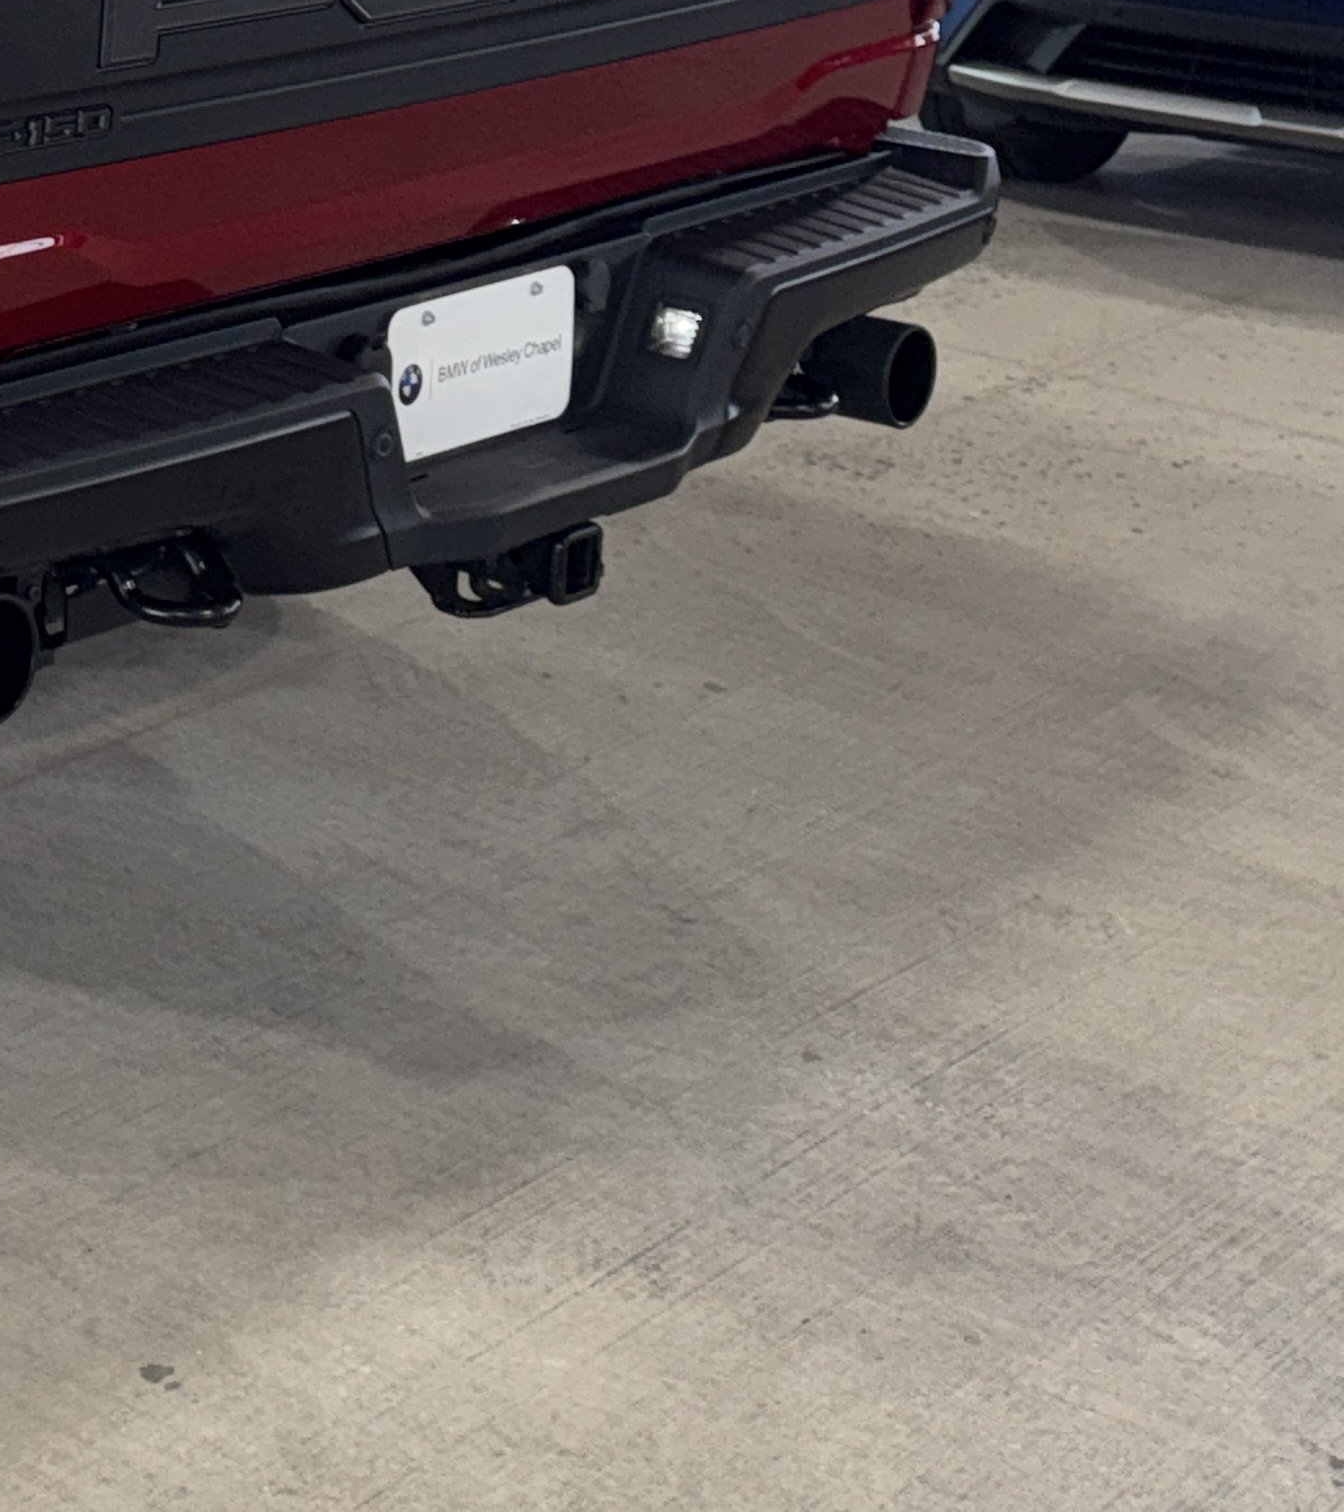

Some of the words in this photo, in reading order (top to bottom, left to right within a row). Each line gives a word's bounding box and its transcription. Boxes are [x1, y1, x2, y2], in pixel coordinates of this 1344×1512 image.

[438, 359, 470, 383] BMW
[470, 354, 482, 374] of
[483, 348, 523, 369] Wesley
[523, 332, 562, 359] Chapel
